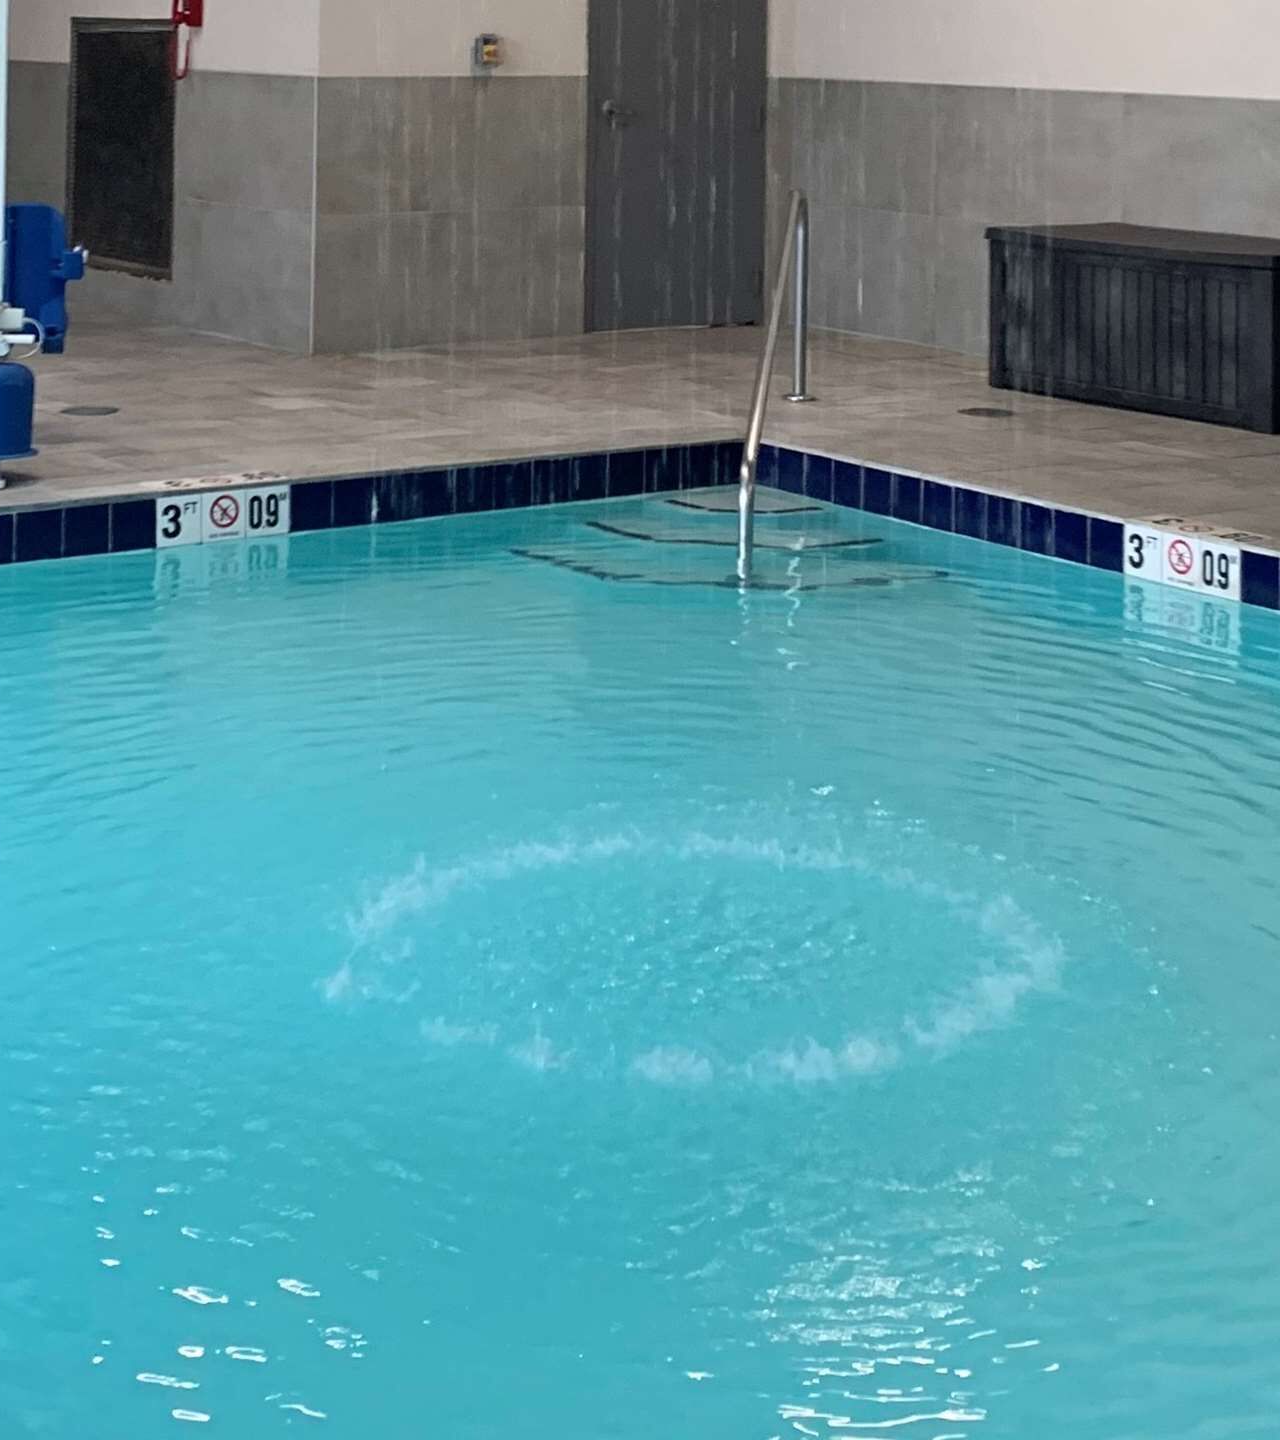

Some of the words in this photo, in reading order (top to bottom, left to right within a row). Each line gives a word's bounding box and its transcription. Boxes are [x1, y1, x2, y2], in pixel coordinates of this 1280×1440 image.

[162, 504, 182, 539] 3
[183, 501, 198, 515] FT
[1129, 533, 1144, 569] 3
